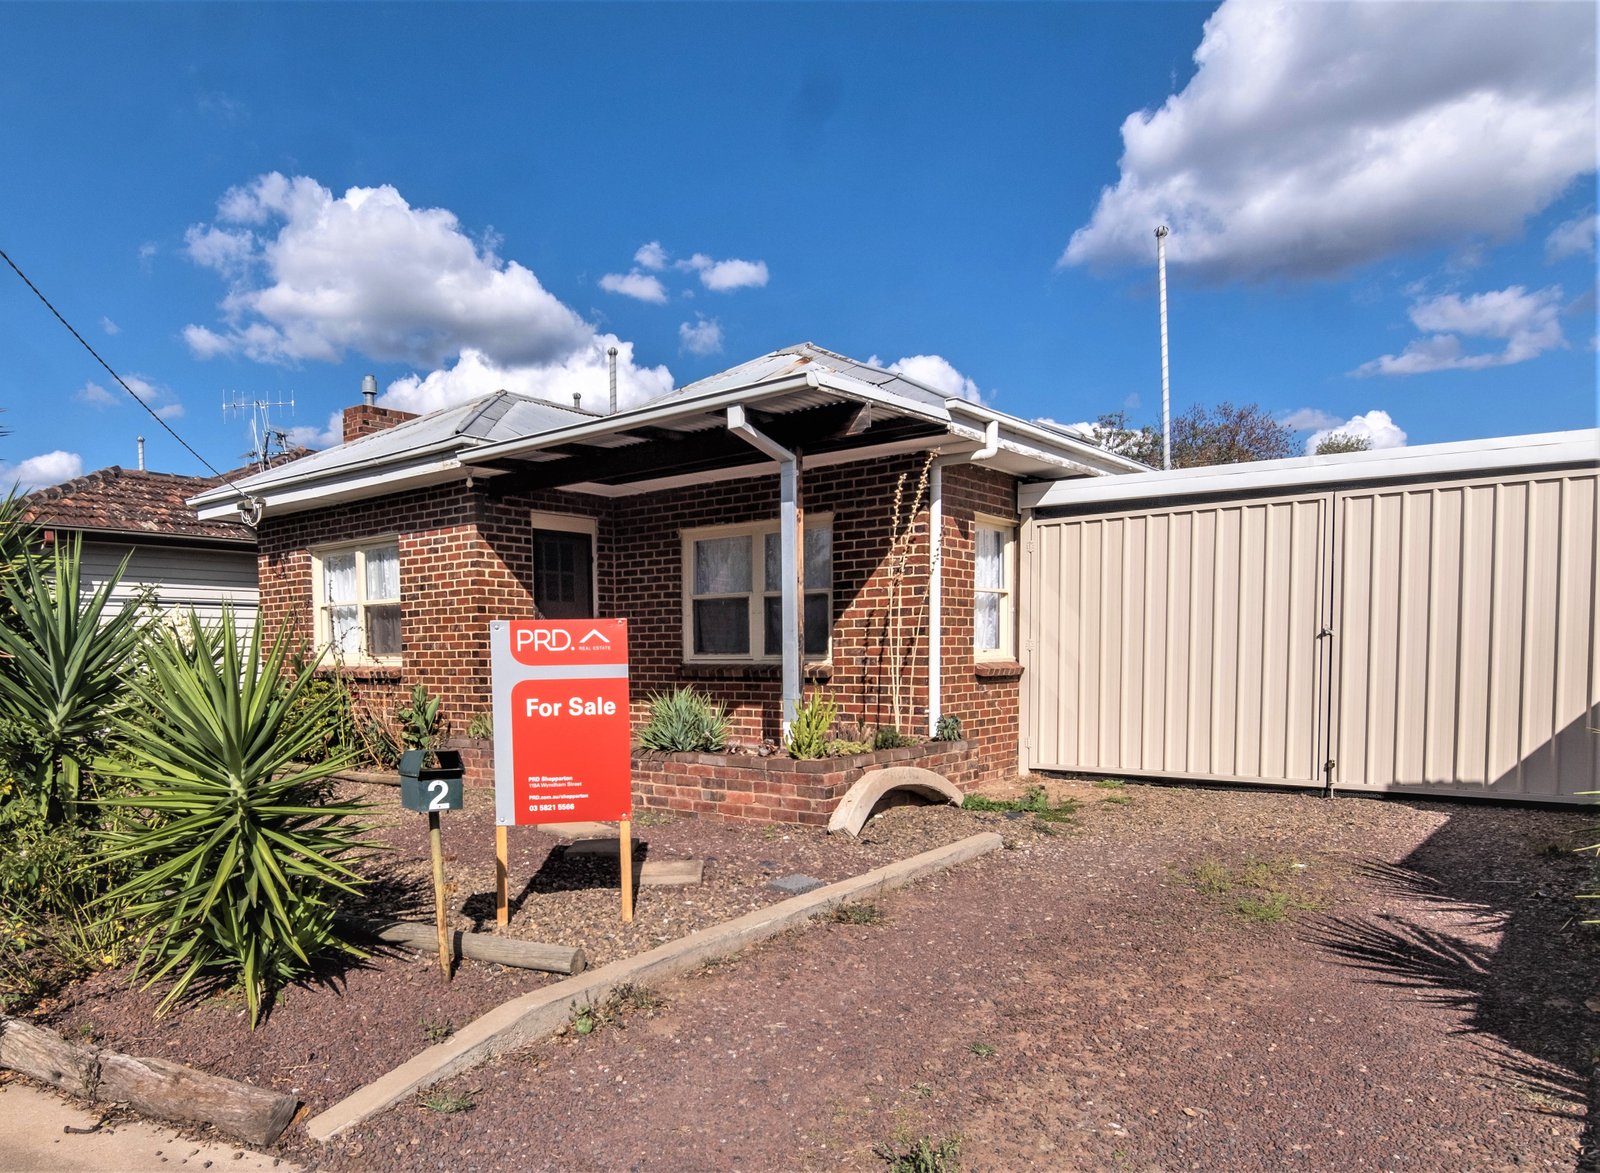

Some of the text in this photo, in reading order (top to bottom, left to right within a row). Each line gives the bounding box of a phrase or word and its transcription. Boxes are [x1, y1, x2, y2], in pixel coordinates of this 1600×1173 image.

[526, 696, 616, 717] For Sale
[428, 780, 450, 810] 2
